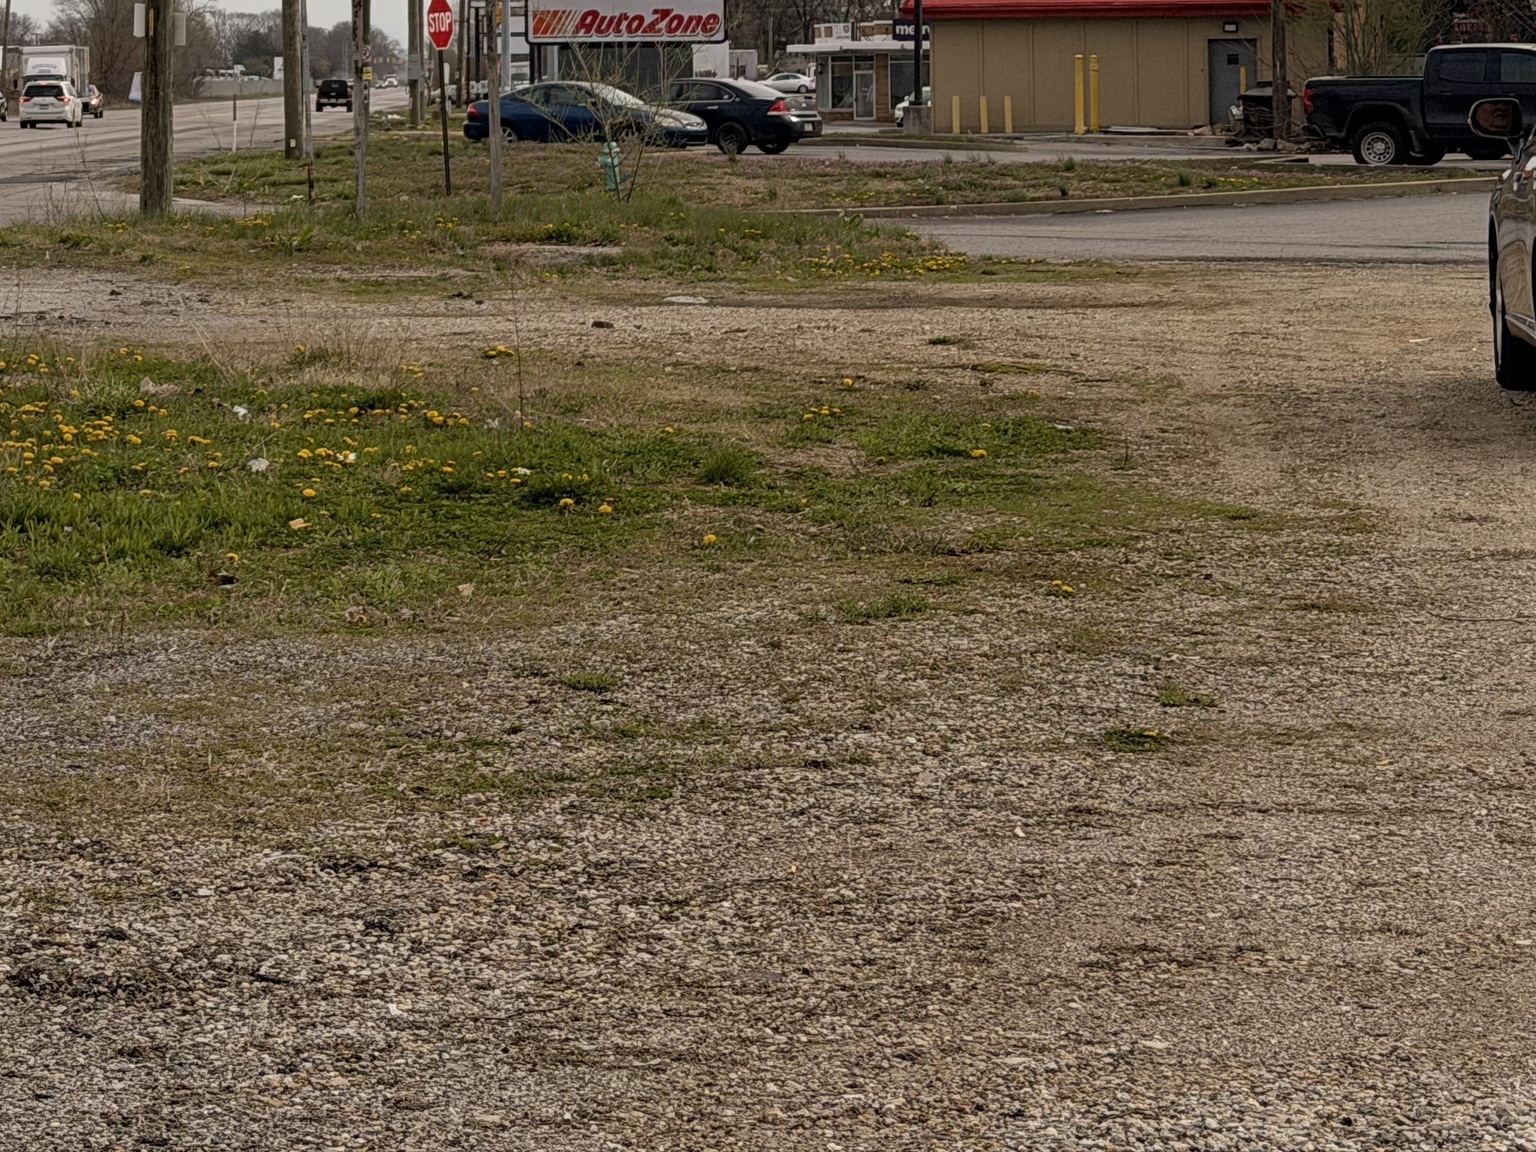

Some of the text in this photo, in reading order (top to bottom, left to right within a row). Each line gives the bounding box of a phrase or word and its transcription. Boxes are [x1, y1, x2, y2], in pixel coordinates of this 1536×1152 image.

[429, 11, 452, 33] STOP
[577, 8, 721, 36] AutoZone
[896, 25, 930, 35] mer
